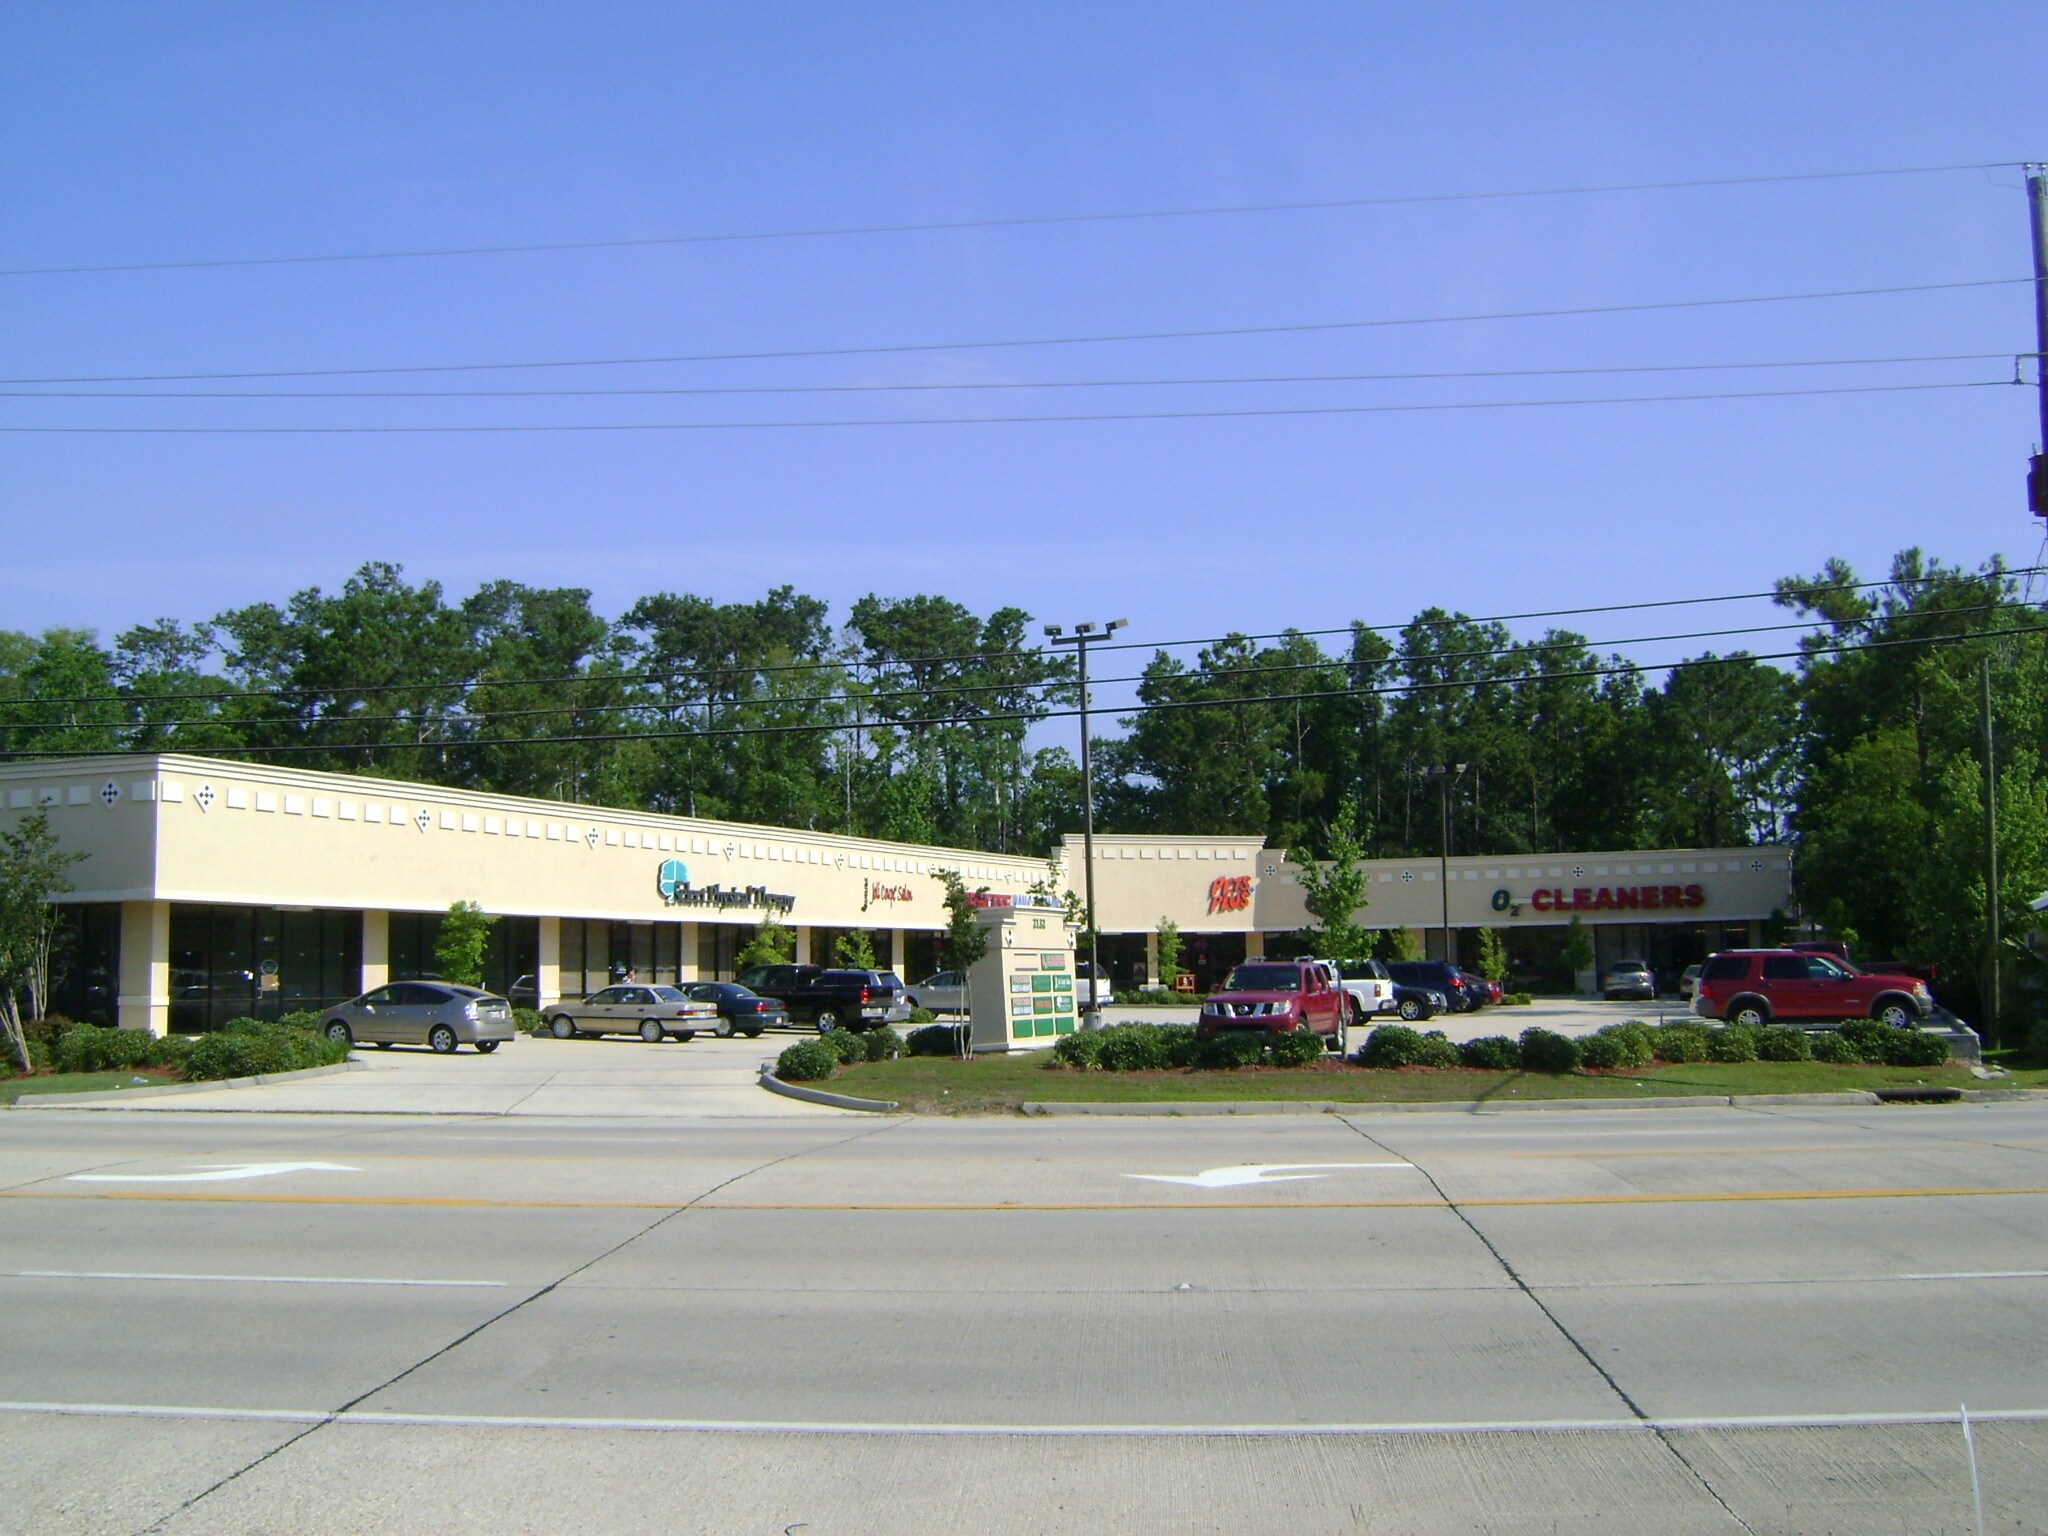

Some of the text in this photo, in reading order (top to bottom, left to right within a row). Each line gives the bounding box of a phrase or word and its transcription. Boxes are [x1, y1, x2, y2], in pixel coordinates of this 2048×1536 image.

[706, 884, 752, 914] Physical
[1208, 875, 1251, 898] PETS
[1531, 884, 1704, 912] CLEANERS
[1207, 893, 1249, 914] PLUS
